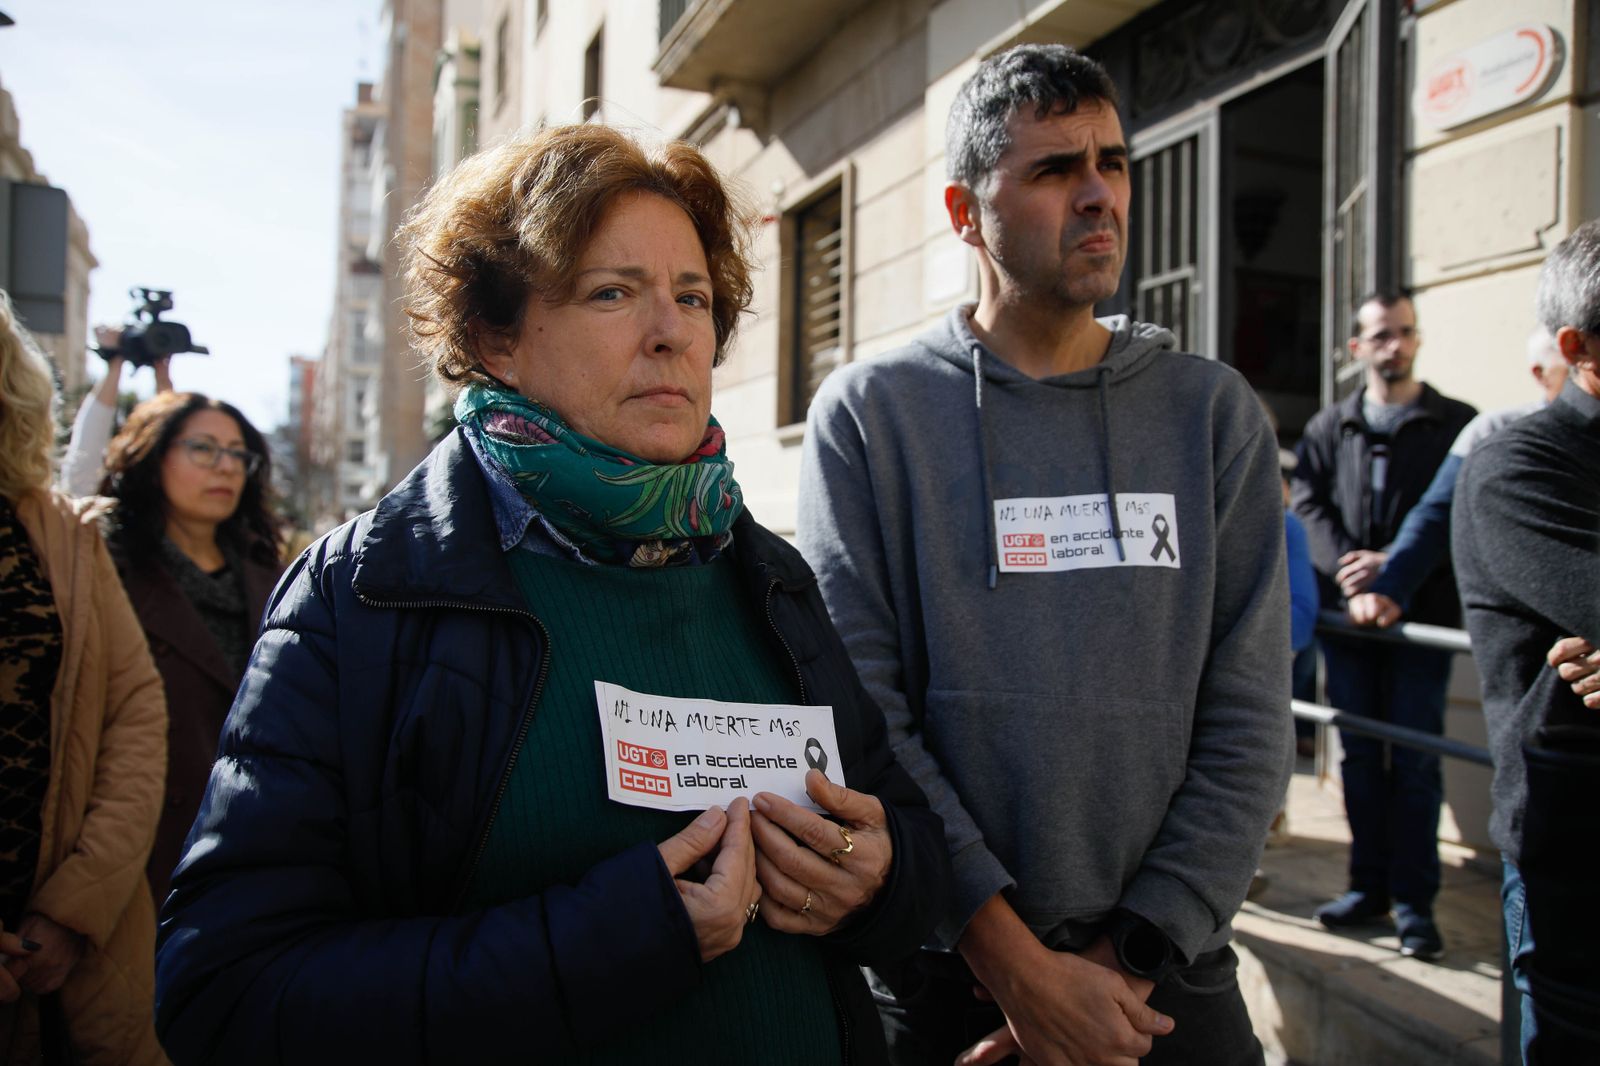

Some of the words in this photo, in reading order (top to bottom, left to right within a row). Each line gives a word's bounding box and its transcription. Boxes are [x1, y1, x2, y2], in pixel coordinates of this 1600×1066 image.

[1000, 506, 1016, 522] NI
[1024, 504, 1053, 521] UNA
[1060, 501, 1112, 519] MUERT
[1004, 535, 1031, 546] UGT
[1050, 534, 1069, 544] en
[1072, 528, 1144, 541] accidnte
[1007, 554, 1046, 564] CCOO
[1051, 544, 1104, 559] laboral
[639, 708, 678, 733] UNA
[686, 712, 761, 737] MUERTE
[618, 745, 650, 764] UGT
[674, 753, 700, 766] en
[705, 753, 798, 769] accidente
[621, 772, 669, 793] CCOO
[676, 772, 748, 789] laboral
